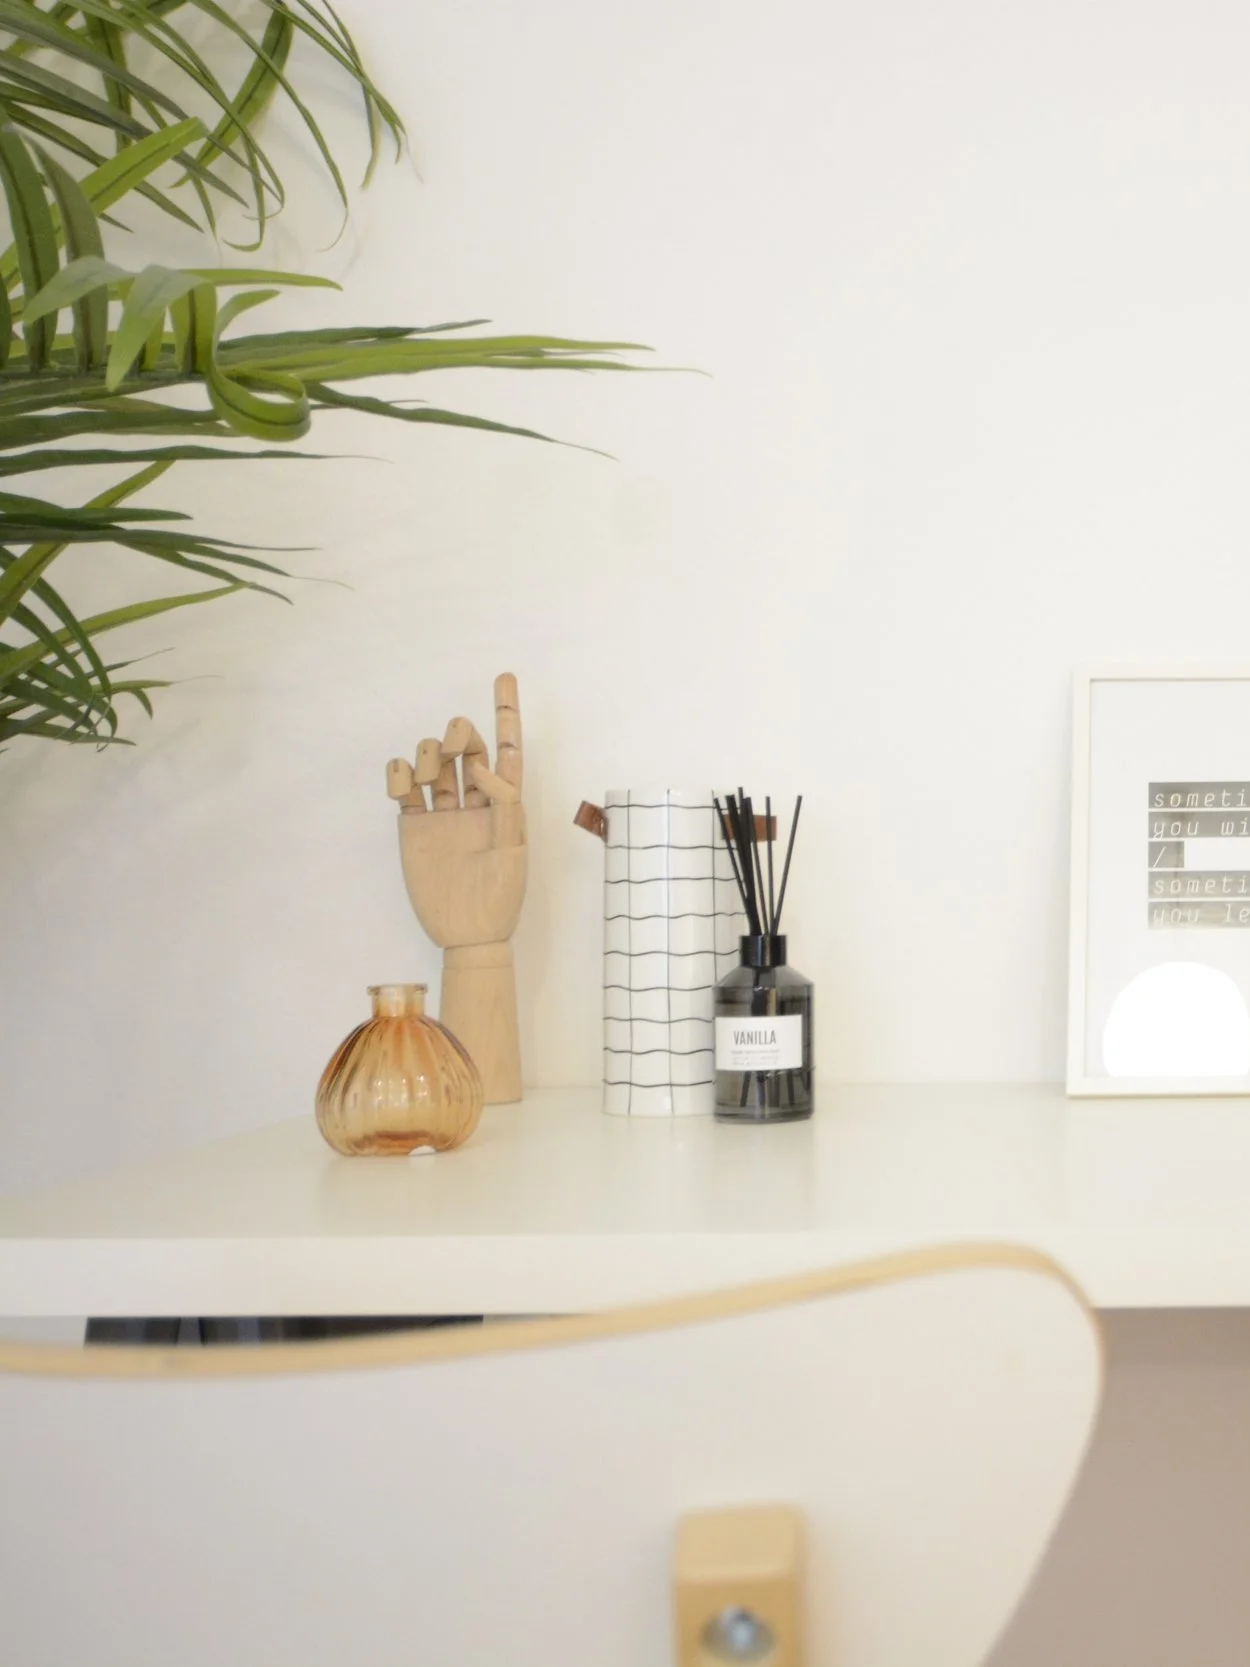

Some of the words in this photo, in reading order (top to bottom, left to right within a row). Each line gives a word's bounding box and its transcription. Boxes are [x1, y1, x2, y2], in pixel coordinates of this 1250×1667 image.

[1152, 820, 1199, 840] you
[1152, 846, 1166, 869] /
[1152, 907, 1199, 926] you
[733, 1030, 777, 1046] VANILLA
